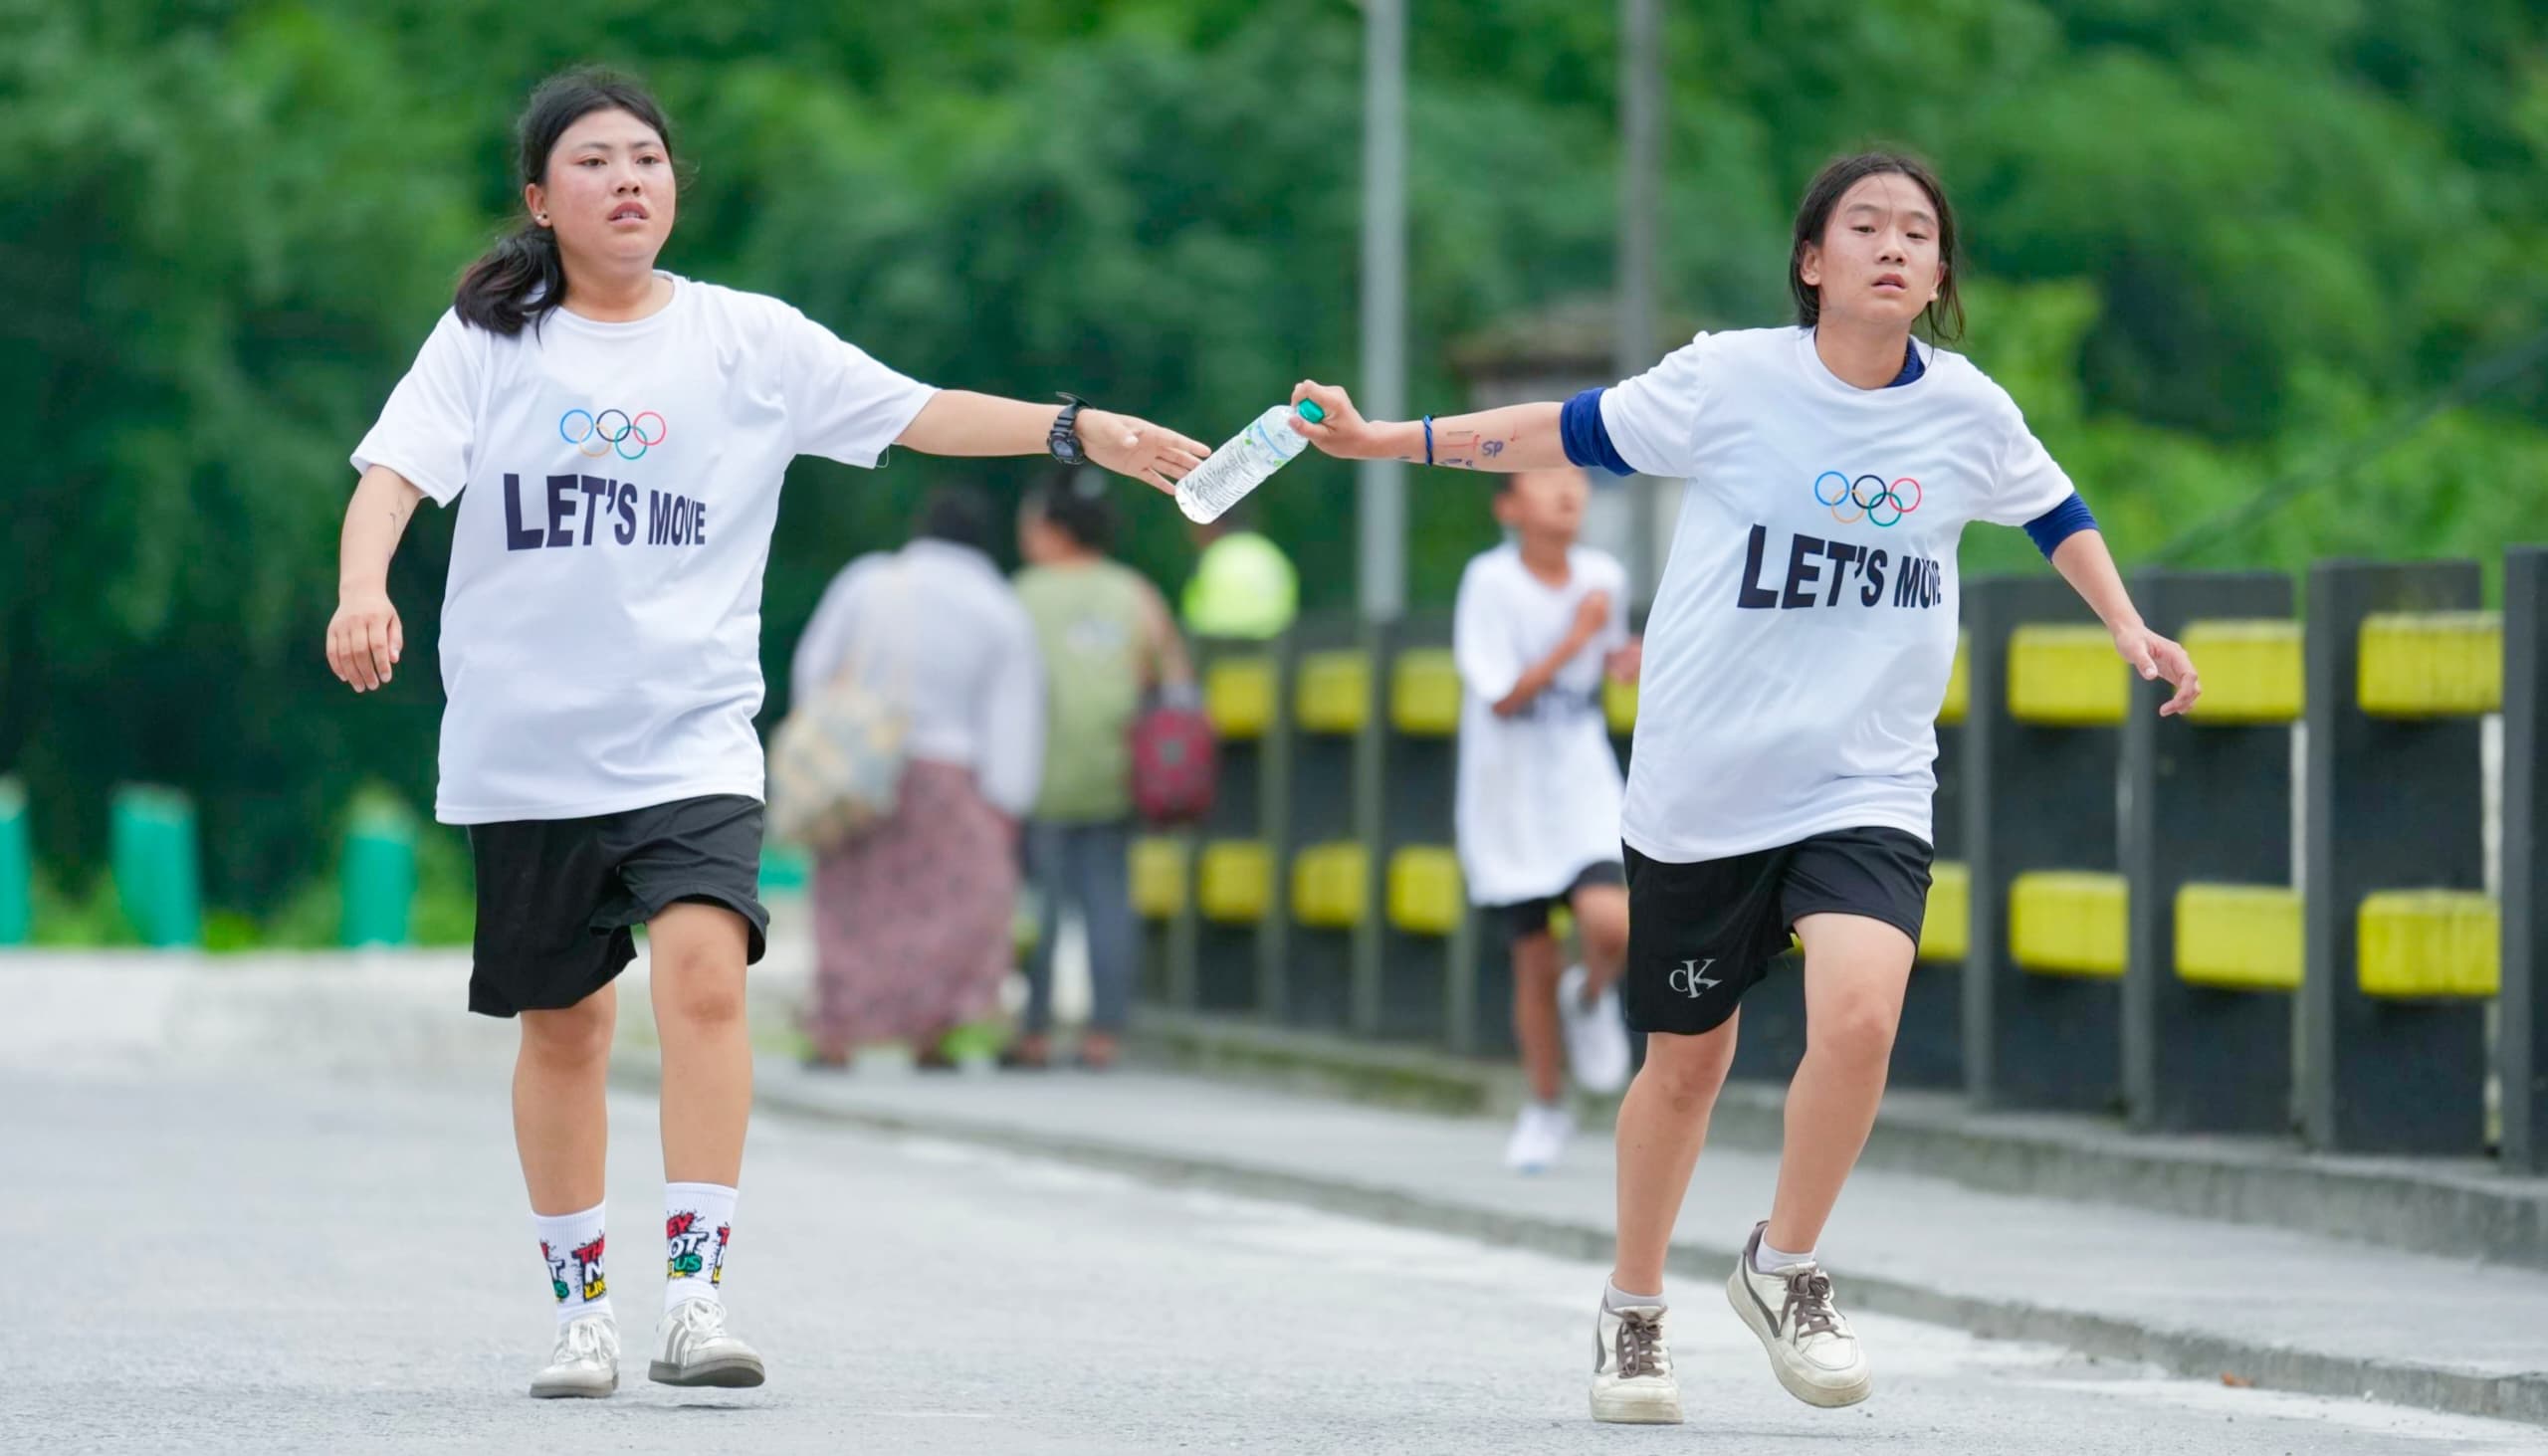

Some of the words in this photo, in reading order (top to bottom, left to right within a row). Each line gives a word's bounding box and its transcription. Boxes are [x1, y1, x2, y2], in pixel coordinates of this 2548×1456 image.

[504, 473, 638, 551] LET'S
[648, 490, 706, 546] MOVE
[1737, 523, 1888, 609] LET'S
[668, 1231, 709, 1260] OT
